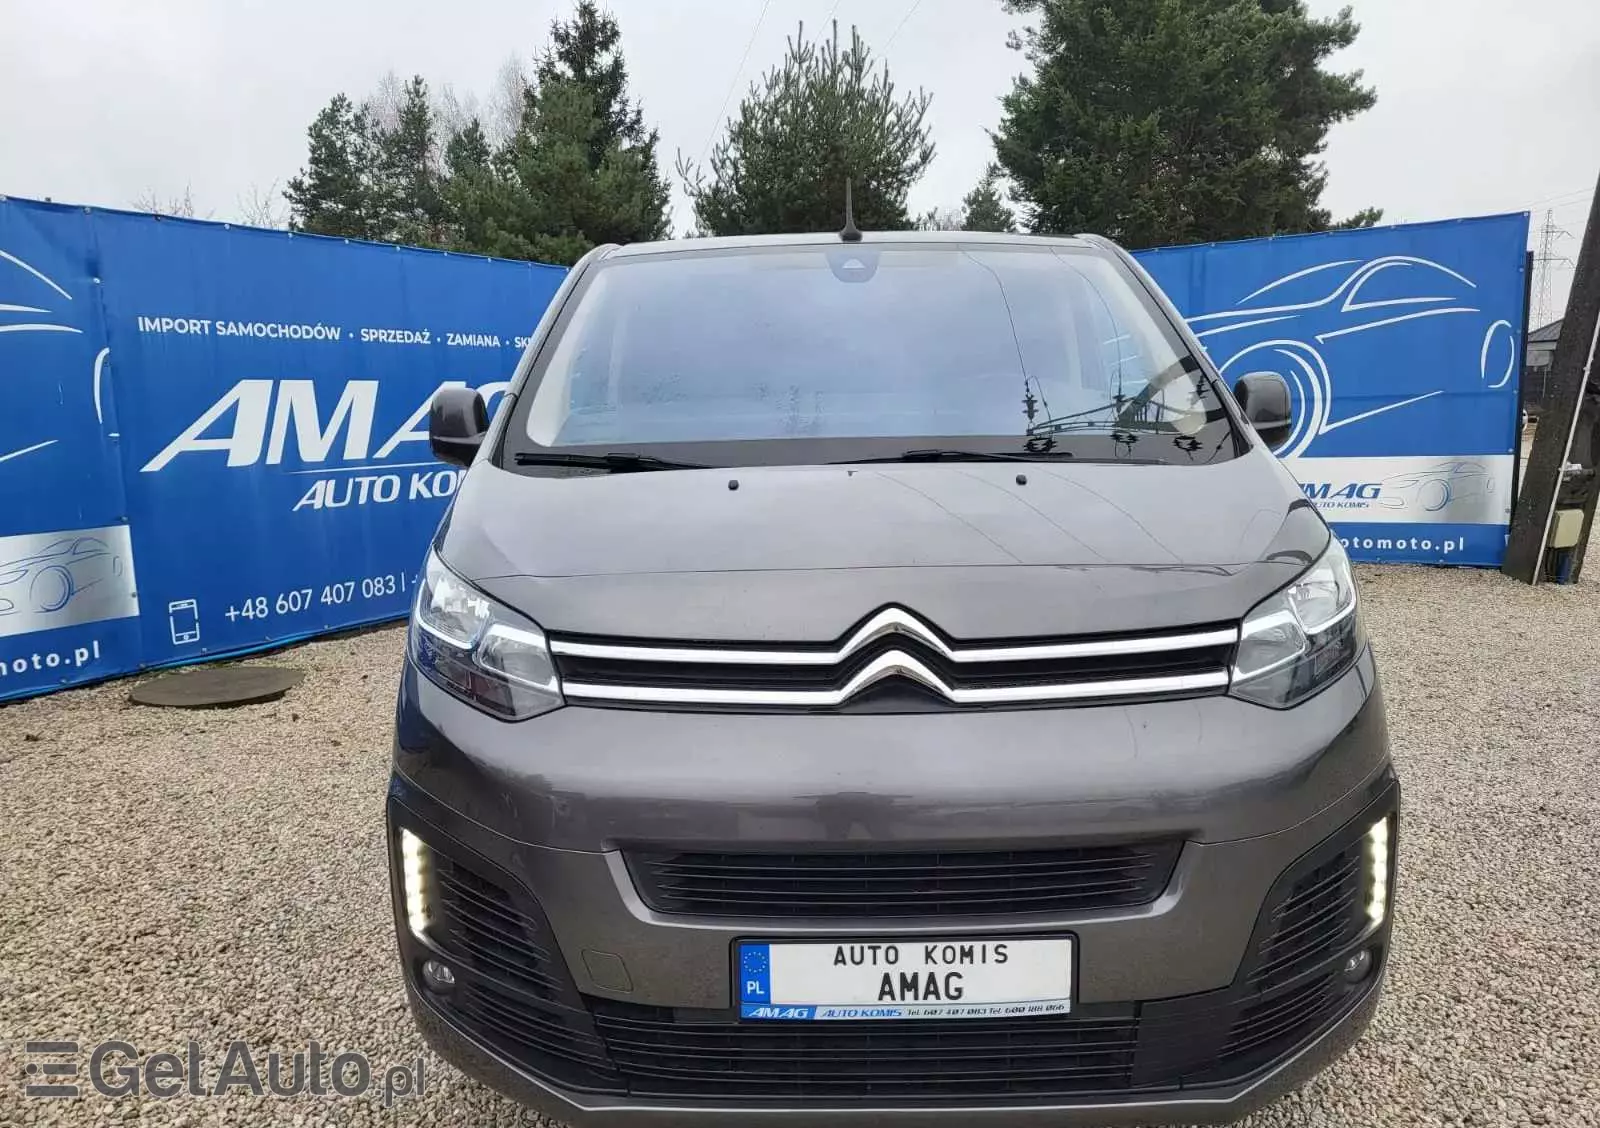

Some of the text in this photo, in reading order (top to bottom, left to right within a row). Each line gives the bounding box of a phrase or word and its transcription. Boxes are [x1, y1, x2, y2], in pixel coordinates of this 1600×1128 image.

[137, 316, 211, 336] IMPORT
[215, 320, 341, 341] SAMOCHODÓW
[360, 328, 431, 345] SPRZEDAŻ
[446, 333, 501, 348] ZAMIANA
[292, 474, 400, 511] AUTO
[225, 574, 396, 622] +48 607 407 083
[833, 943, 1009, 966] AUTO KOMIS
[746, 981, 765, 995] PL
[877, 971, 964, 1001] AMAG
[749, 1006, 809, 1018] AMAG
[822, 1007, 857, 1018] AUTO
[860, 1007, 902, 1017] KOMIS
